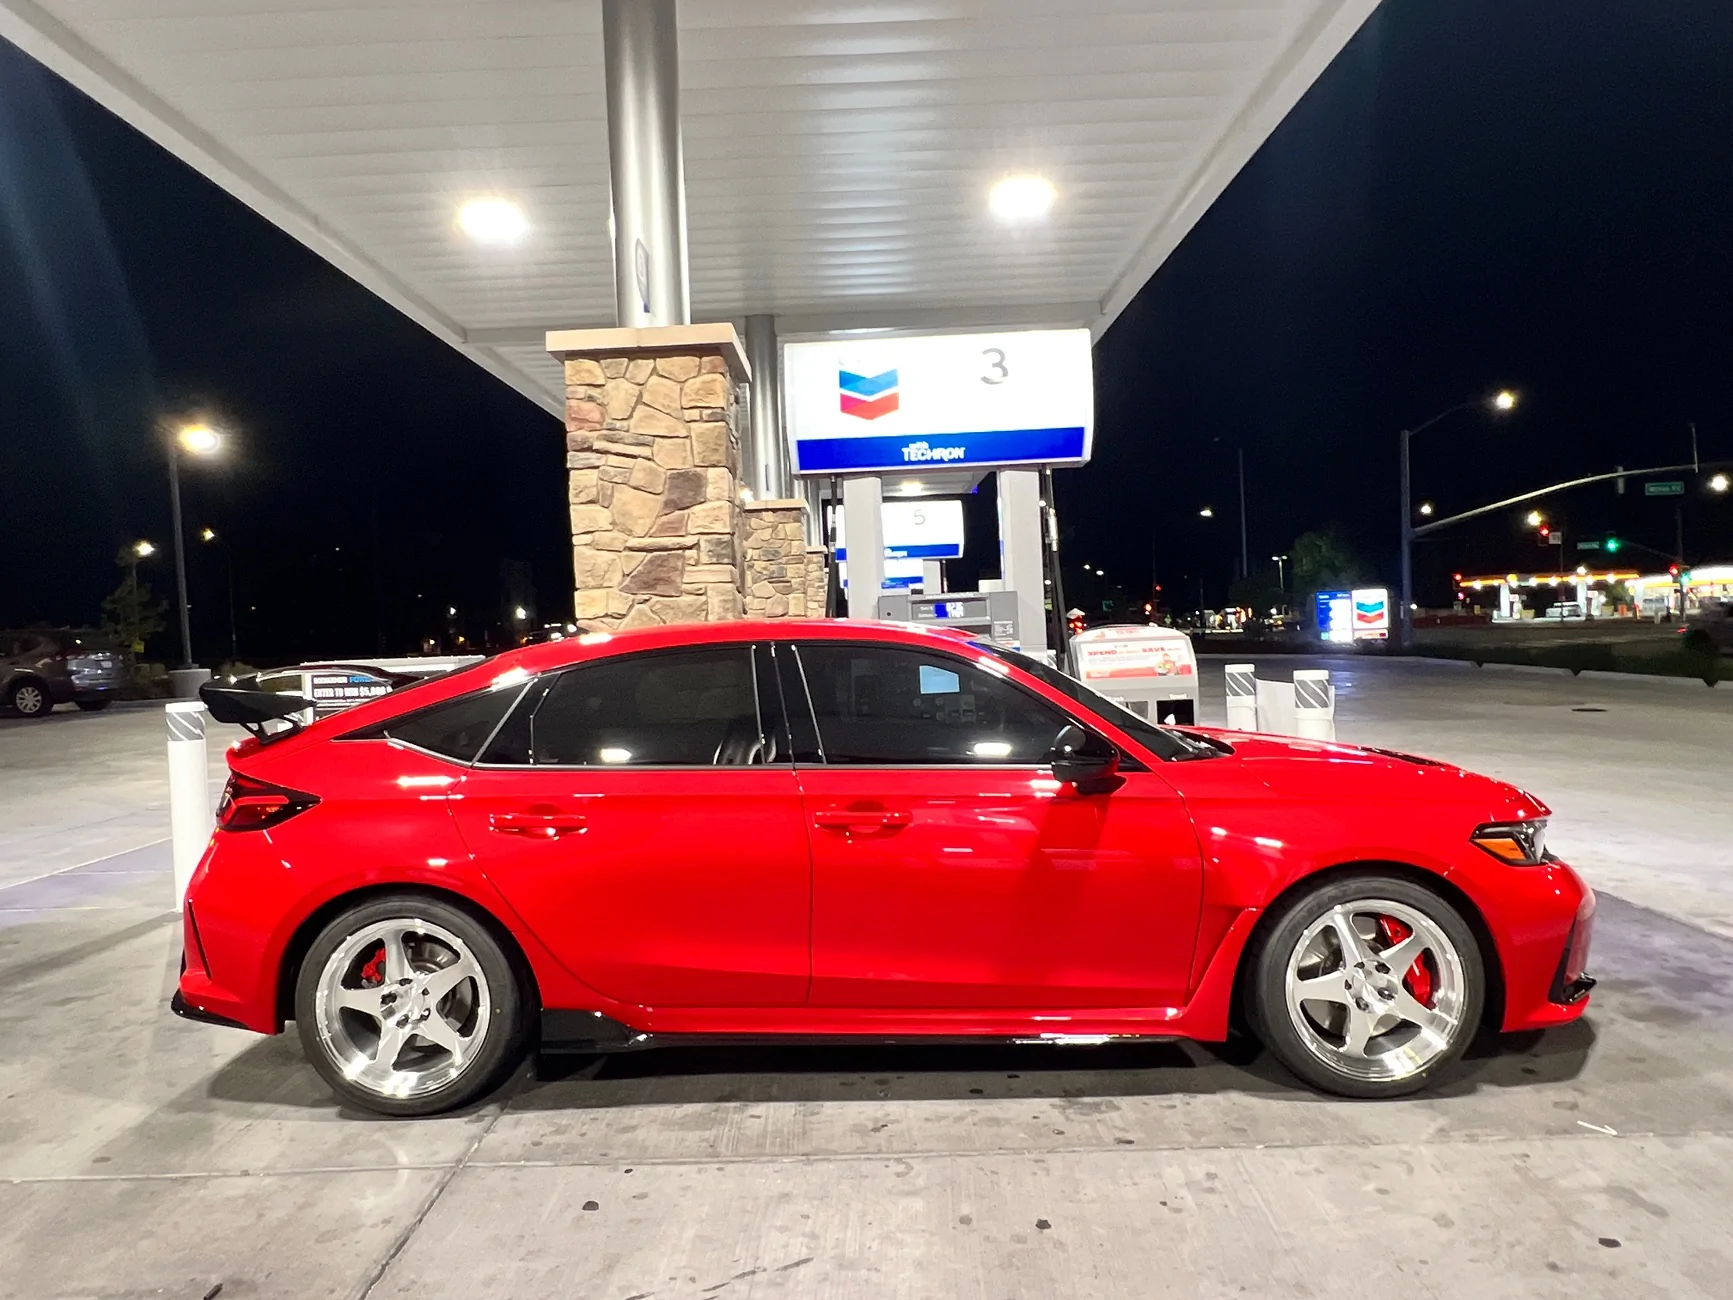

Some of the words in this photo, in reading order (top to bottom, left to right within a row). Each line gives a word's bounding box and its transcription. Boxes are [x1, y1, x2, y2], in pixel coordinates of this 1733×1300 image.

[980, 347, 1009, 385] 3
[901, 447, 966, 462] TECHRON
[914, 509, 926, 525] 5
